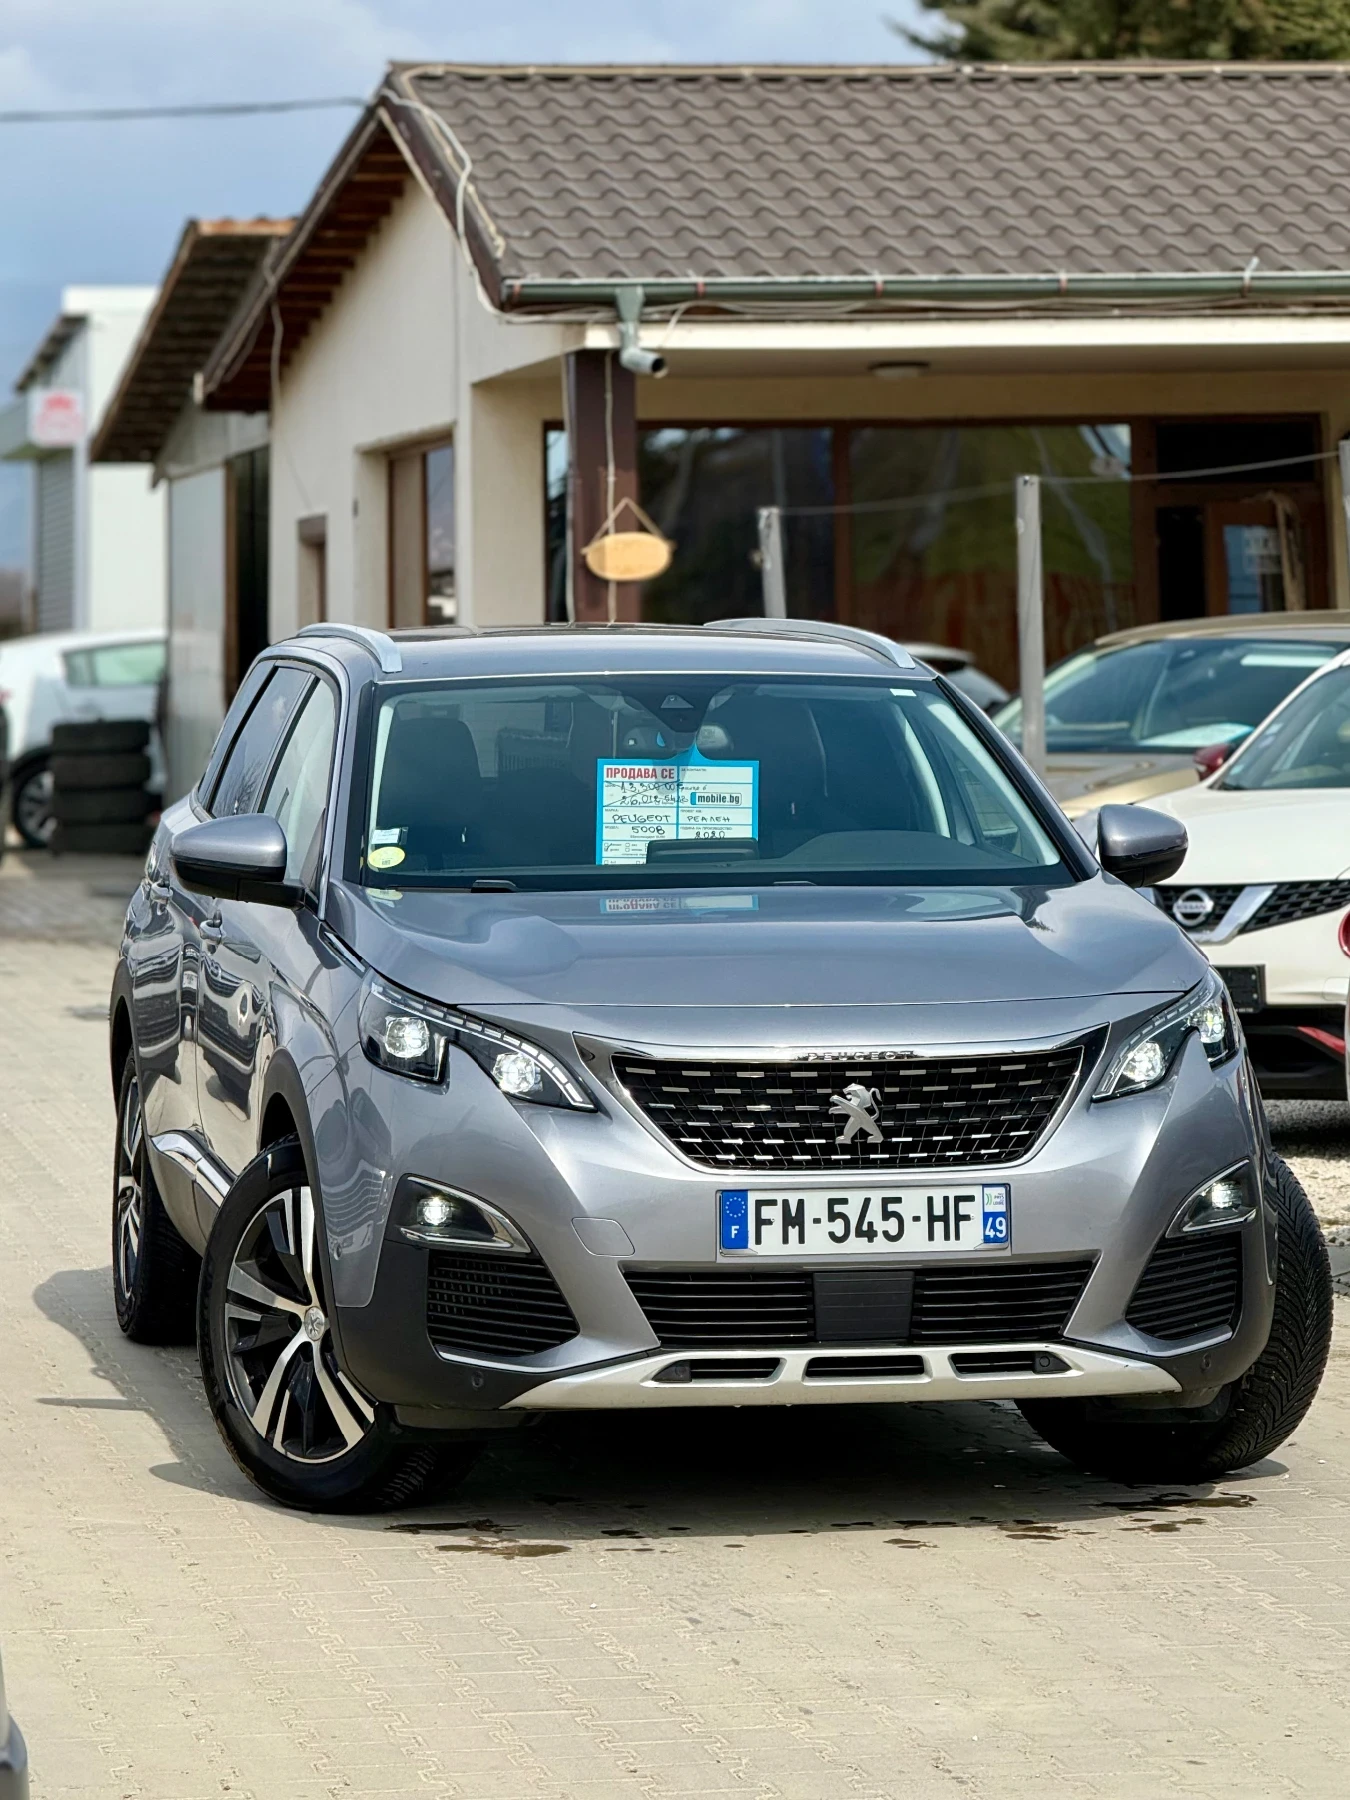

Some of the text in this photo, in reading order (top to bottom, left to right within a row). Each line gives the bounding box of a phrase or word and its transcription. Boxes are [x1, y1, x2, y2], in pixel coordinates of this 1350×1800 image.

[606, 767, 675, 780] ПРОДАВА СЕ
[697, 794, 740, 805] mobile.bg
[612, 814, 671, 824] PEUGEOT
[632, 825, 665, 835] 5008
[807, 1050, 914, 1061] PEUGEOT
[754, 1195, 976, 1246] FM-545-HF
[731, 1225, 739, 1239] F
[985, 1216, 1006, 1238] 49
